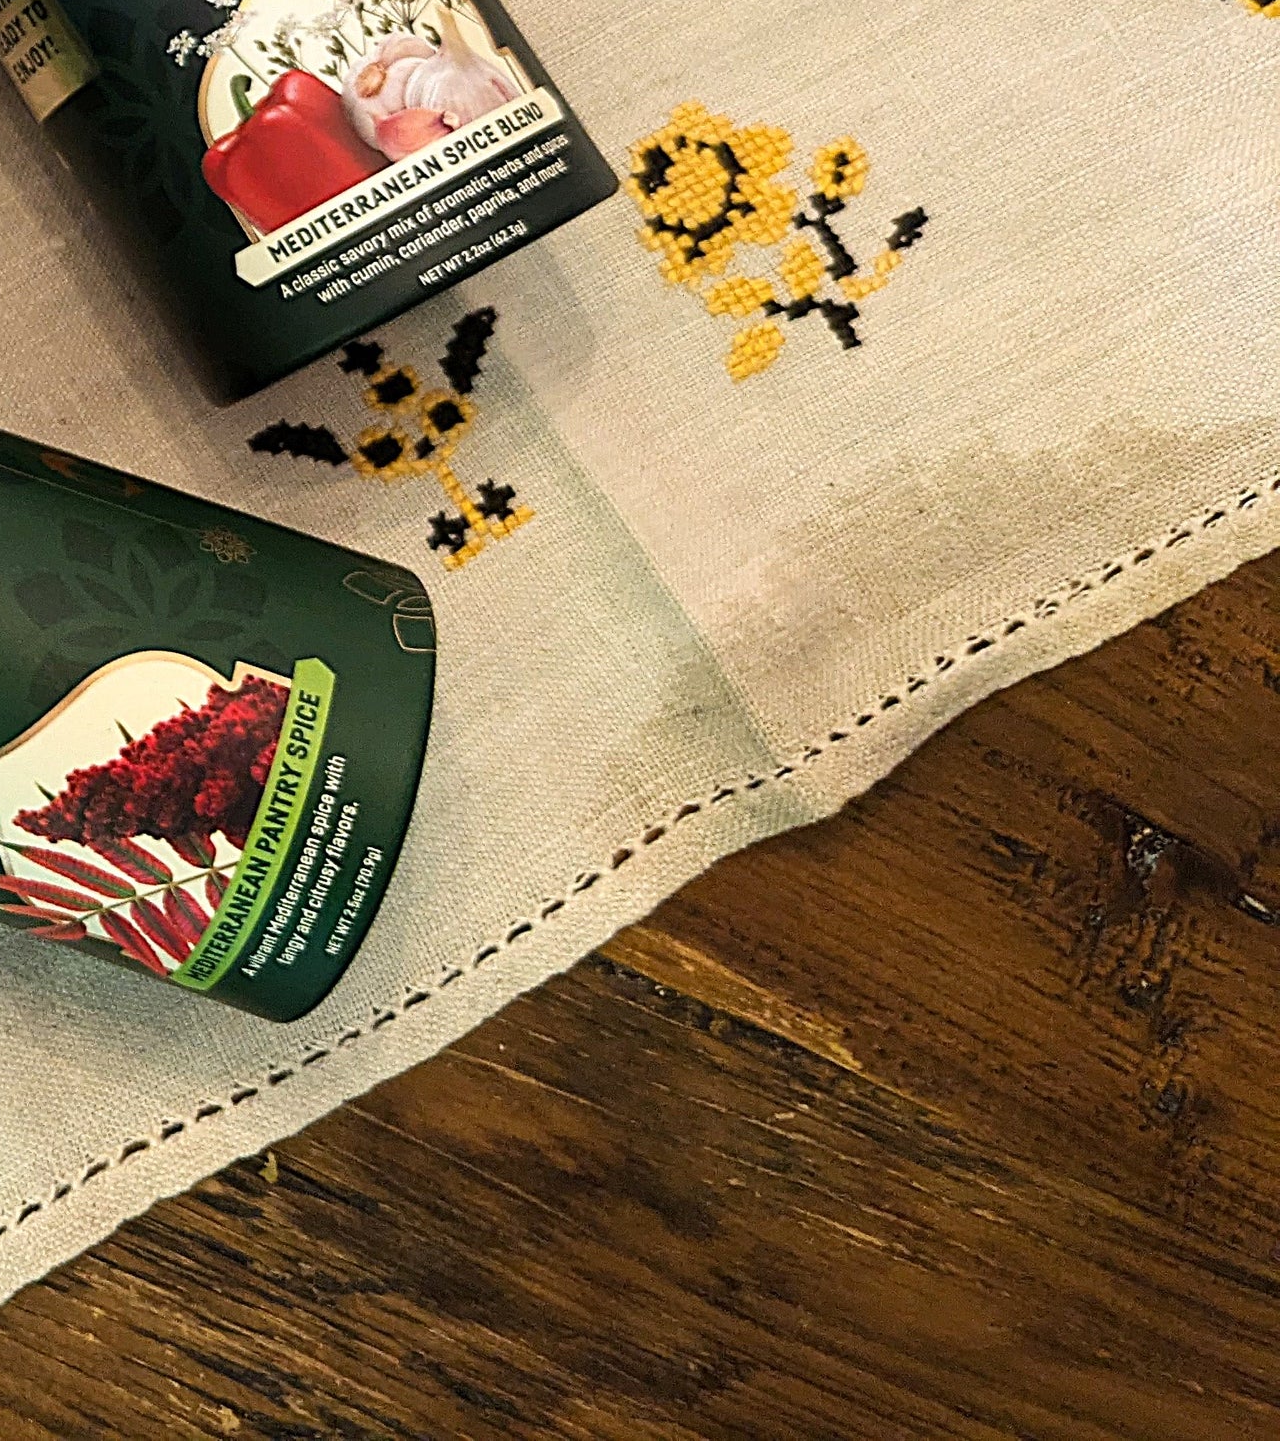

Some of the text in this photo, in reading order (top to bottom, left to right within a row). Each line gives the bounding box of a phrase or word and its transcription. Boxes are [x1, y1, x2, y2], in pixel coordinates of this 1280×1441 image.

[21, 0, 48, 27] TO
[267, 101, 544, 264] MEDITERRANEAN SPICE BLEND
[280, 132, 569, 299] A classic savory mix of aromatic herbs and spices
[317, 277, 350, 303] with
[352, 253, 399, 286] cumin,
[398, 217, 468, 258] coriander,
[468, 188, 520, 224] paprika,
[517, 173, 539, 193] and
[418, 267, 442, 286] NET
[441, 256, 462, 273] WT
[463, 239, 491, 263] 2.2oz
[183, 690, 321, 982] MEDITERRANEAN PANTRY SPICE
[241, 754, 346, 978] A vibrant Mediterranean spice with
[276, 802, 360, 966] tangy and citrusy flavors.
[324, 933, 341, 956] NET
[335, 917, 351, 934] WT
